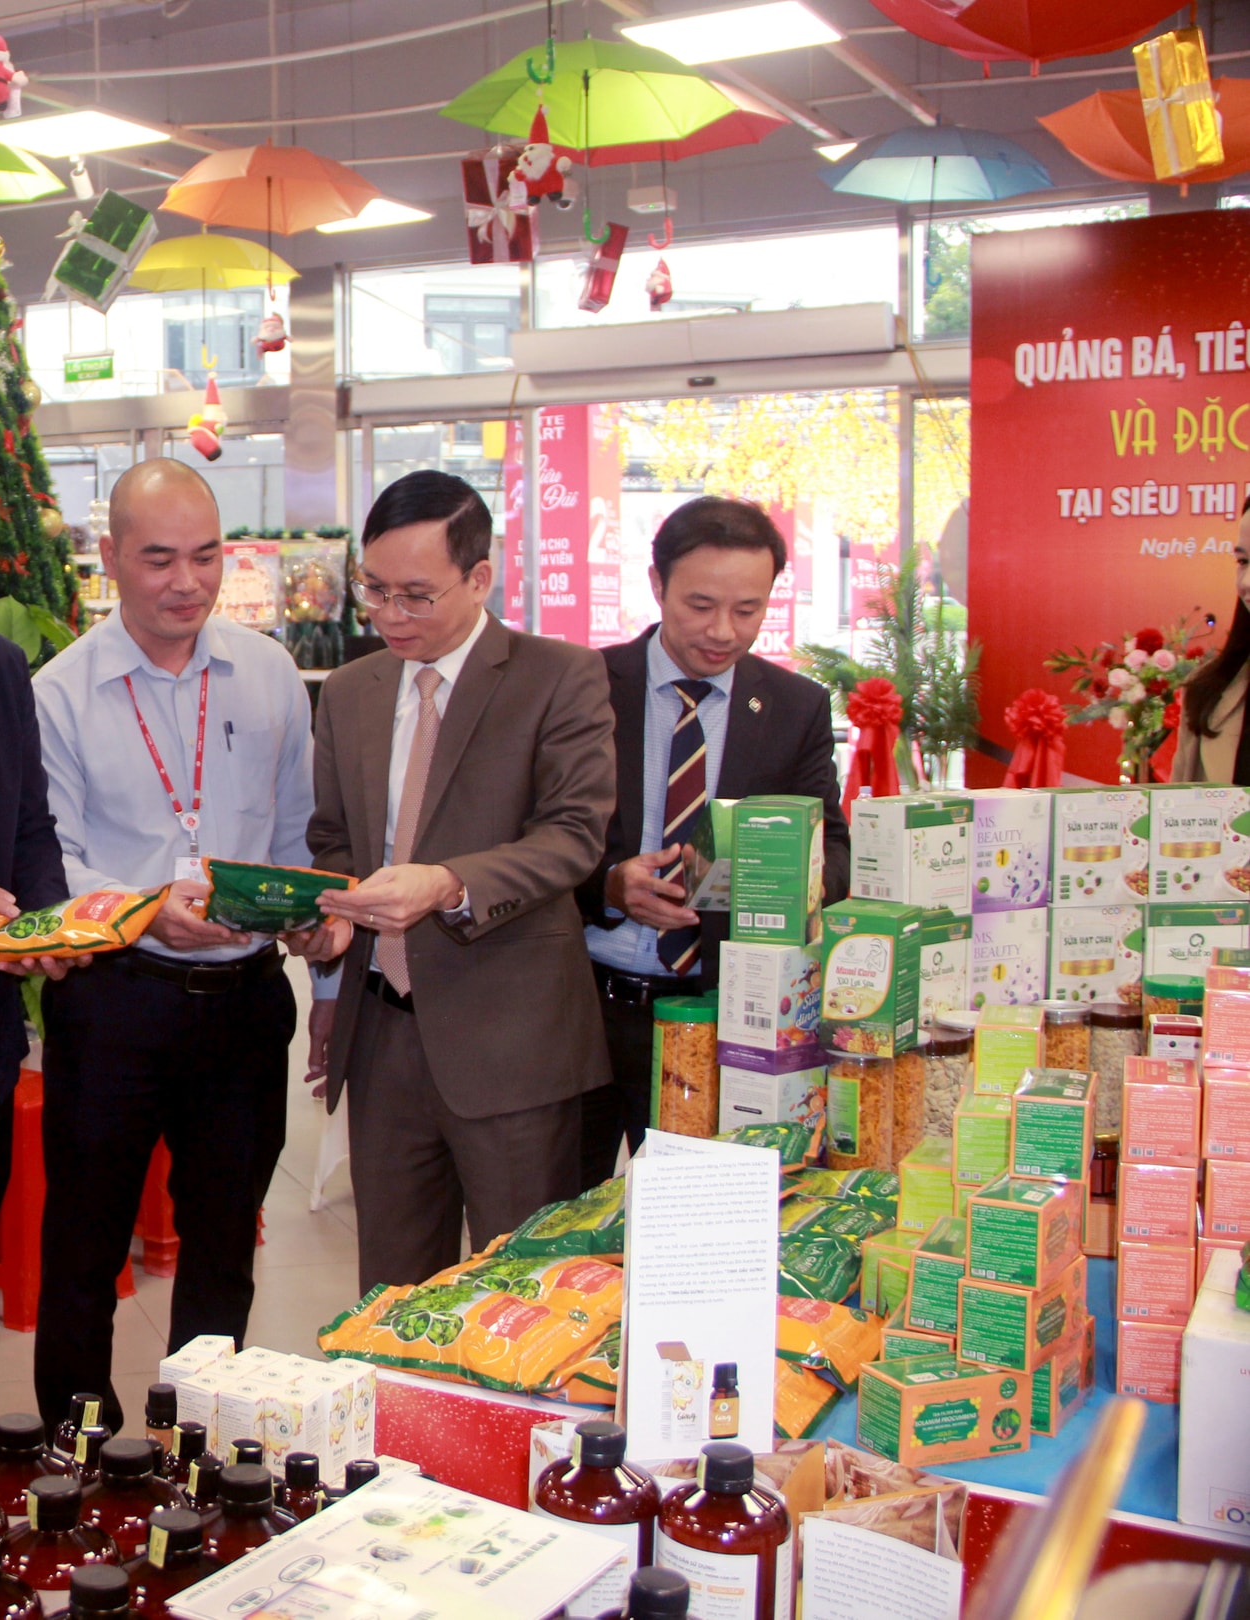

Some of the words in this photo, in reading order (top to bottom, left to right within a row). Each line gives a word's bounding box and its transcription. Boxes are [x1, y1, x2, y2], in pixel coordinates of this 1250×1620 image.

[1015, 328, 1122, 387] QUẢNG
[1132, 326, 1185, 380] BÁ,
[1110, 398, 1156, 456] VÀ
[1057, 487, 1102, 523] TẠI
[1111, 480, 1180, 515] SIÊU
[1187, 483, 1236, 519] THỊ
[1139, 537, 1197, 559] Nghệ
[548, 572, 569, 592] 09
[977, 829, 1023, 844] BEAUTY
[973, 945, 1020, 959] BEAUTY
